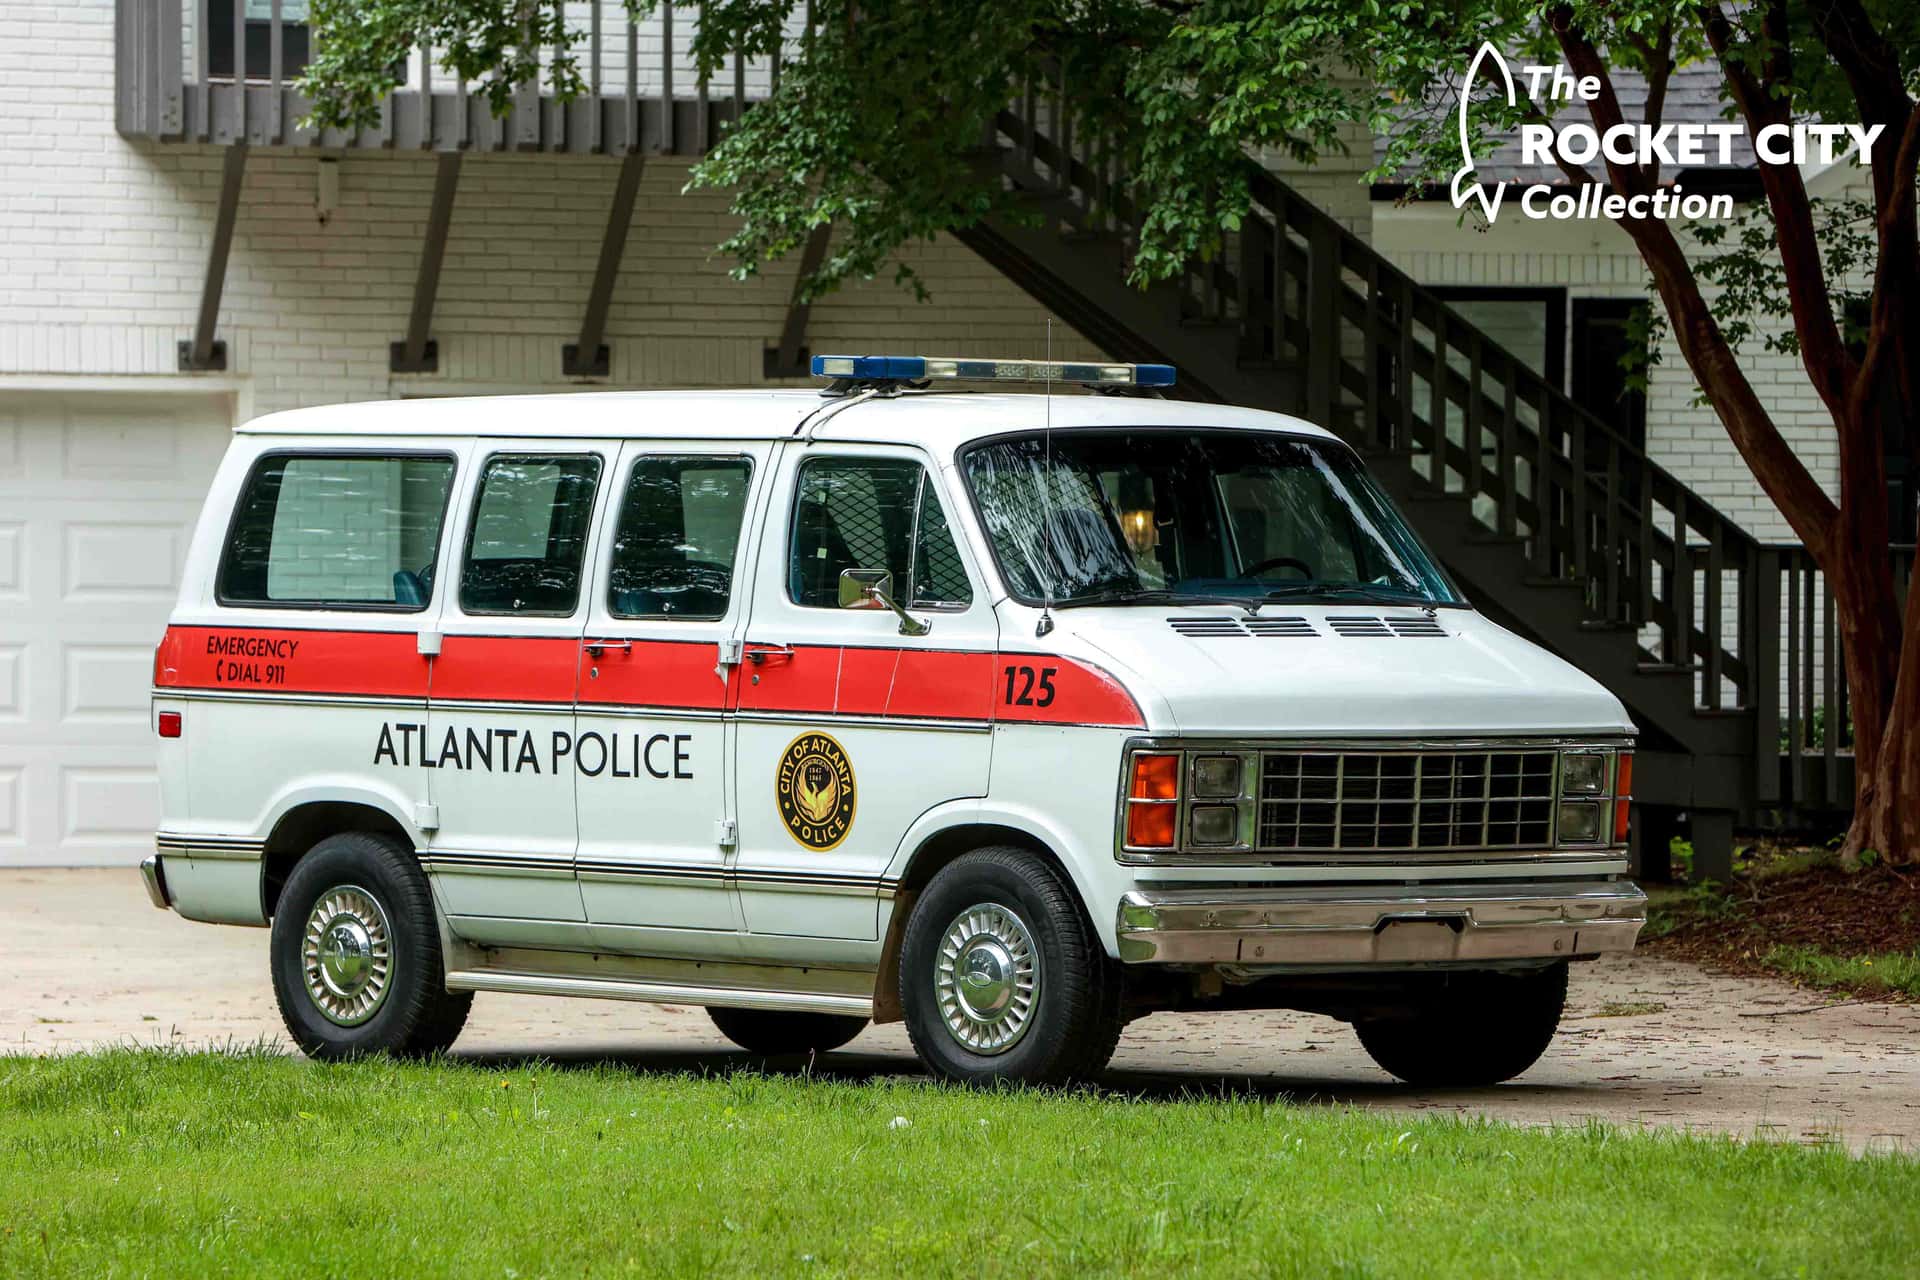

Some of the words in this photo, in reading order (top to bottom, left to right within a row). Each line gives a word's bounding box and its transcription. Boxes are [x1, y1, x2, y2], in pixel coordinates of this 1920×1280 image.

[207, 635, 299, 659] EMERGENCY
[227, 662, 262, 683] DIAL
[265, 664, 285, 684] 911
[1004, 666, 1057, 707] 125
[373, 722, 541, 775] ATLANTA
[552, 731, 694, 779] POLICE
[780, 756, 795, 794] CITY
[793, 740, 809, 759] OF
[811, 738, 852, 796] ATLANTA
[791, 815, 845, 843] POLICE
